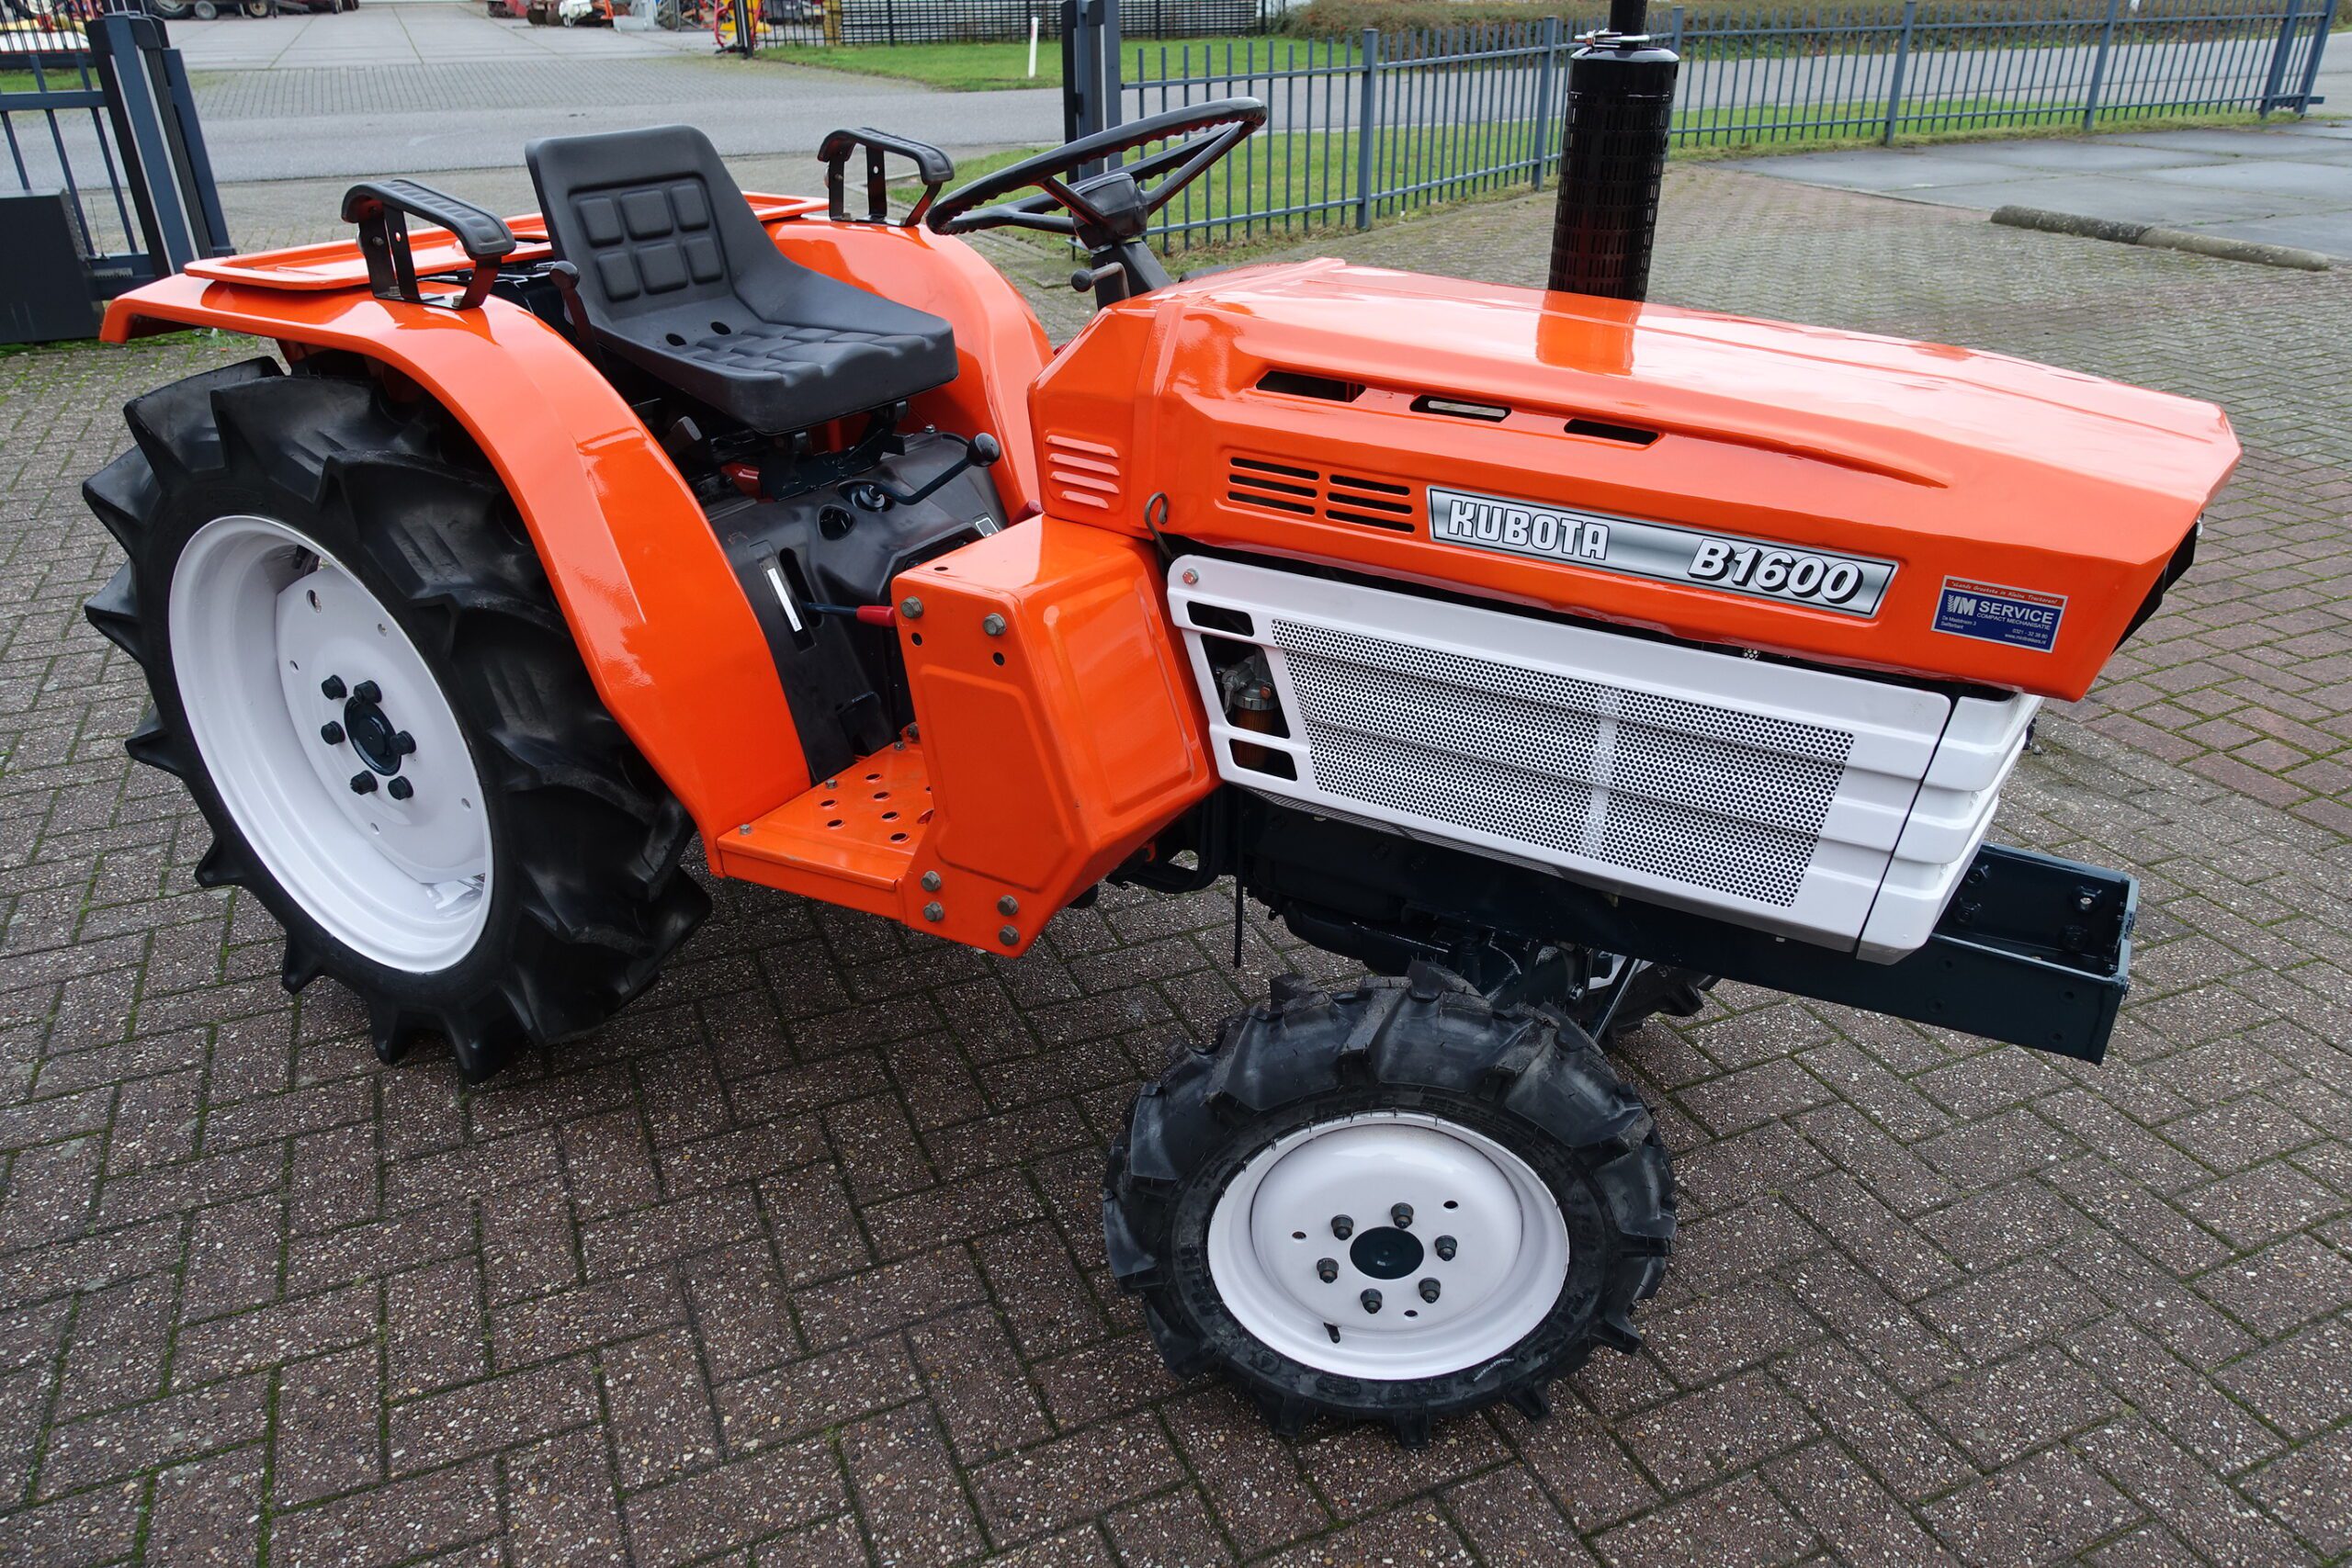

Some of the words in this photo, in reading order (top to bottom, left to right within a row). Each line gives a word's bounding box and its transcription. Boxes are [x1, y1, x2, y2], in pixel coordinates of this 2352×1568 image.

[1447, 499, 1610, 561] KUBOTA
[1688, 537, 1864, 606] B1600
[1976, 612, 2007, 623] COMPACT
[2007, 617, 2051, 631] MECHANISATIE
[1979, 602, 2054, 625] SERVICE
